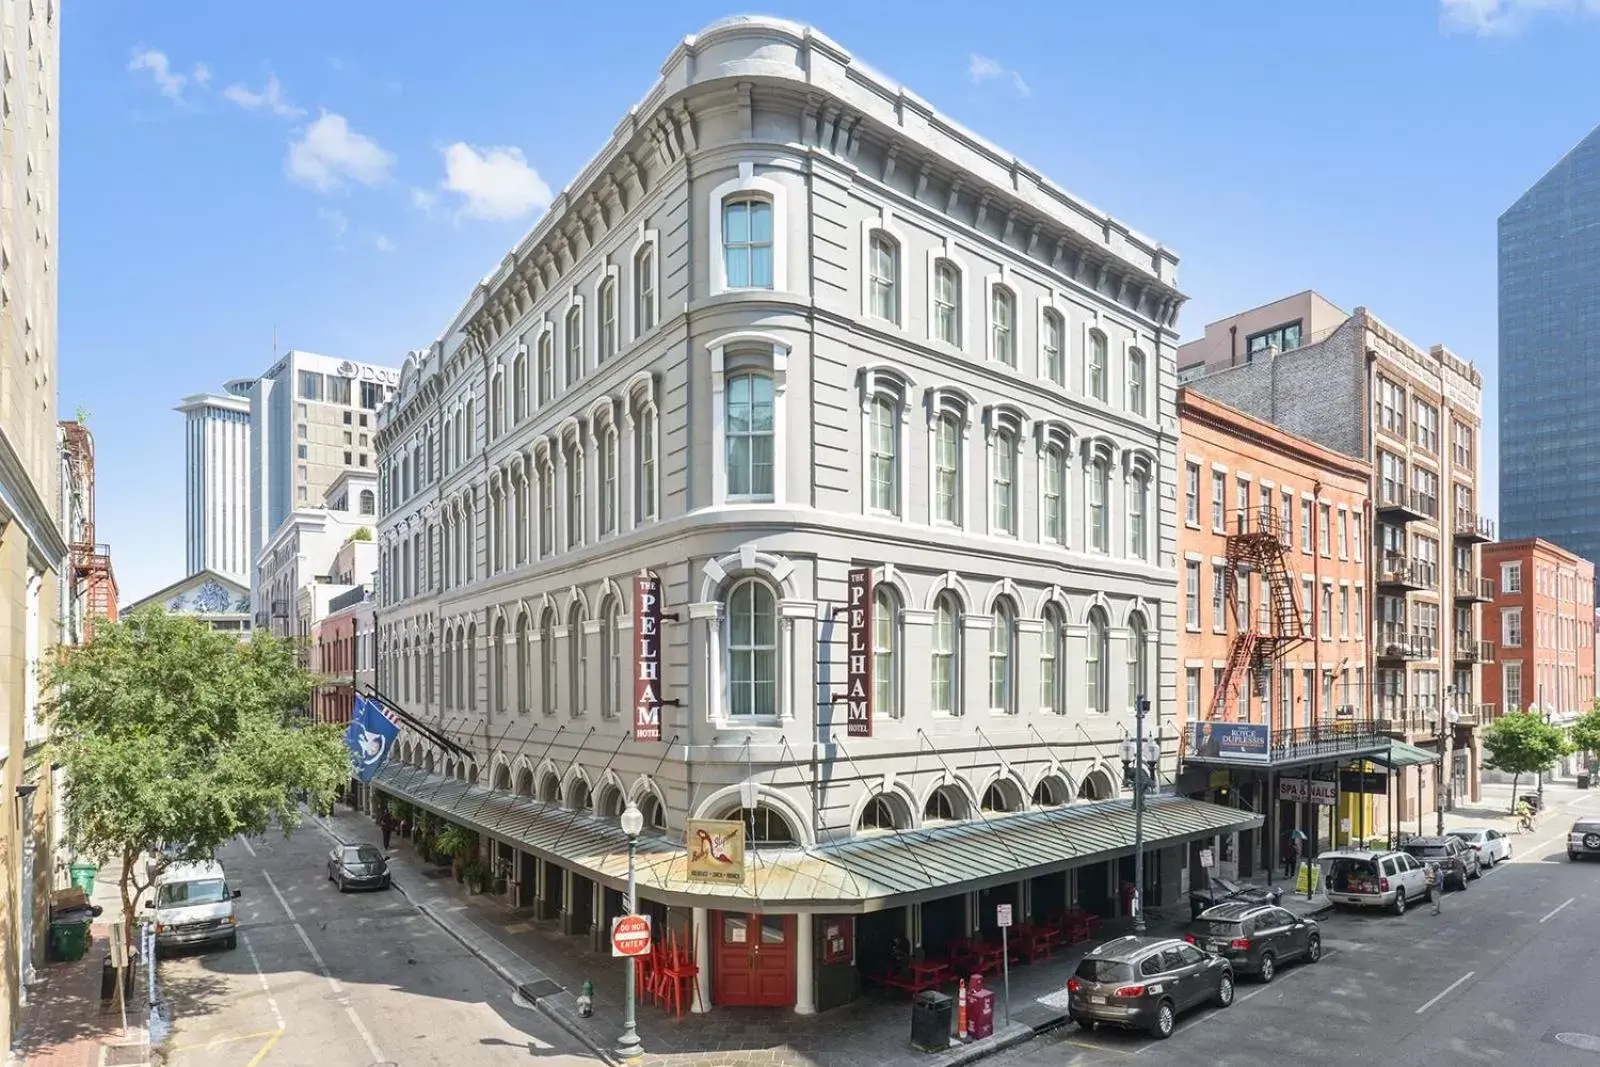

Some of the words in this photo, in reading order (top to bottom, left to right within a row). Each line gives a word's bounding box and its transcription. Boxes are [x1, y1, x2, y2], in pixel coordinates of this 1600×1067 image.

[851, 573, 864, 582] THE
[639, 581, 656, 590] THE
[849, 586, 868, 720] PELHAM
[637, 593, 660, 726] PELHAM
[849, 723, 867, 733] HOTEL
[636, 729, 660, 738] HOTEL
[1281, 783, 1297, 795] SPA
[1310, 786, 1336, 799] NAILS
[631, 922, 646, 930] NOT
[620, 940, 645, 948] ENTER
